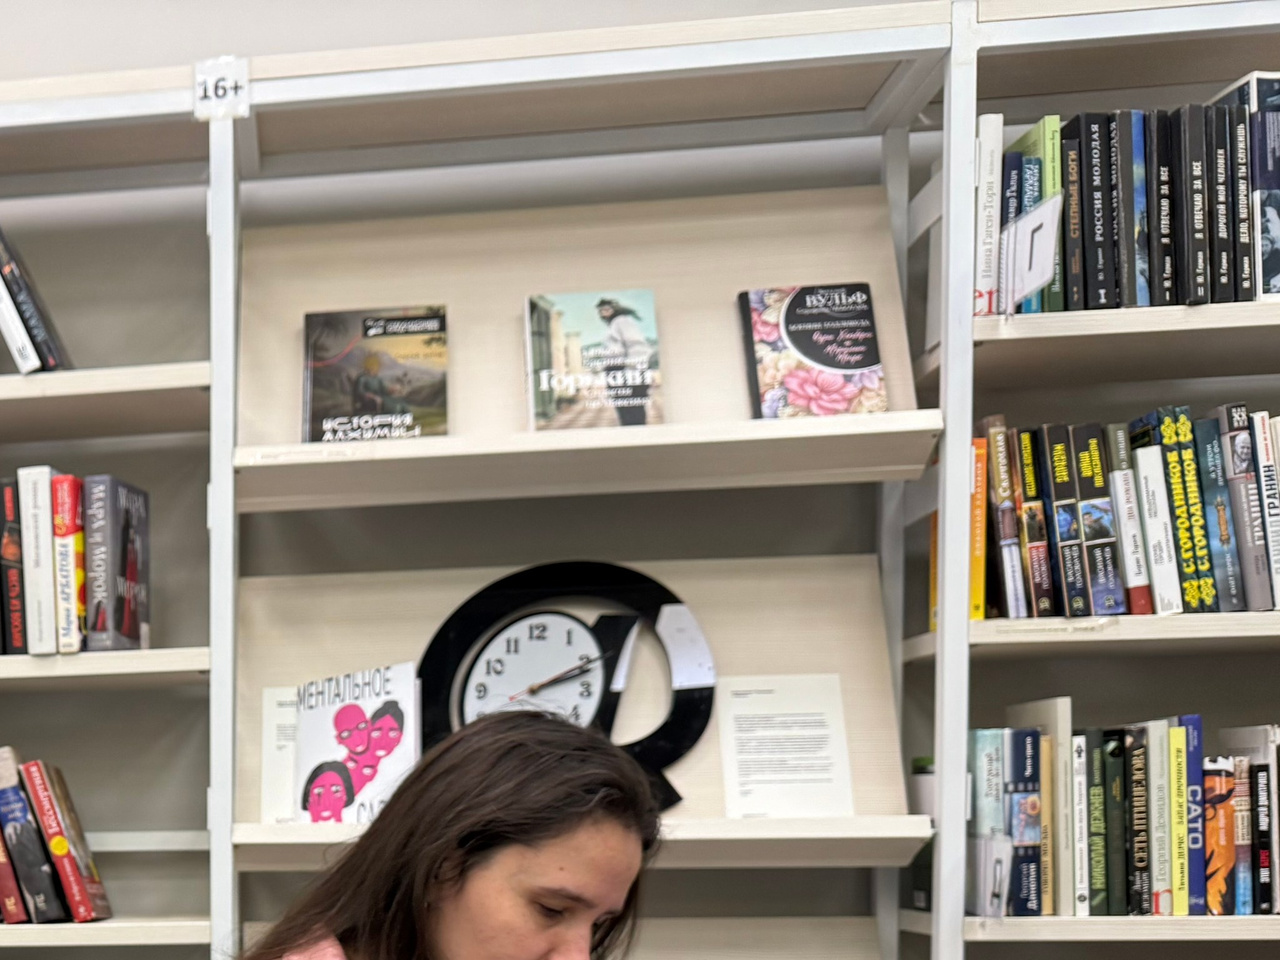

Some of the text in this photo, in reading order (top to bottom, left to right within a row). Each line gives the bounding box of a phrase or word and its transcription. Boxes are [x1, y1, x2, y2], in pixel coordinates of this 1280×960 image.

[198, 77, 242, 100] 16+
[1091, 124, 1101, 186] МОЛОДАЯ
[1193, 161, 1202, 175] ВСЕ
[1160, 166, 1169, 181] ВСЕ
[1160, 184, 1169, 195] ЗА
[1193, 179, 1202, 190] ЗА
[1068, 150, 1079, 238] СТЕПНЫЕ БОГИ
[1194, 192, 1203, 229] ОТВЕЧАЮ
[1236, 123, 1250, 288] Ю. Герман ДЕЛО, КОТОРОМУ ТЫ СЛУЖИШЬ
[1093, 191, 1104, 241] РОССИЯ
[1160, 198, 1170, 234] ОТВЕЧАЮ
[1216, 148, 1228, 283] Ю. Герман ДОРОГОЙ МОЙ ЧЕЛОВЕК
[1028, 222, 1044, 272] Г
[1195, 251, 1203, 273] Герман
[1163, 256, 1171, 278] Герман
[1196, 274, 1204, 283] Ю.
[806, 291, 868, 308] ВУЛЬФ
[1262, 464, 1280, 517] ГРАНИН
[1248, 483, 1265, 546] ГРАНИН
[58, 542, 74, 639] Мария АРБАТОВА
[505, 637, 519, 654] 11
[527, 623, 547, 641] 12
[566, 628, 572, 646] 1
[485, 658, 504, 676] 10
[298, 667, 392, 712] МЕНТАЛЬНОЕ
[475, 682, 487, 700] 9
[579, 680, 592, 698] 3
[1258, 771, 1268, 805] ДМИТРИЕВ
[1131, 747, 1148, 867] СЕТЬ ПТИЦЕЛОВА
[1188, 785, 1203, 849] САТО
[1089, 785, 1106, 890] НИКОЛАЙ ДЕЖНЕВ
[1154, 784, 1168, 883] Георгий Демидов
